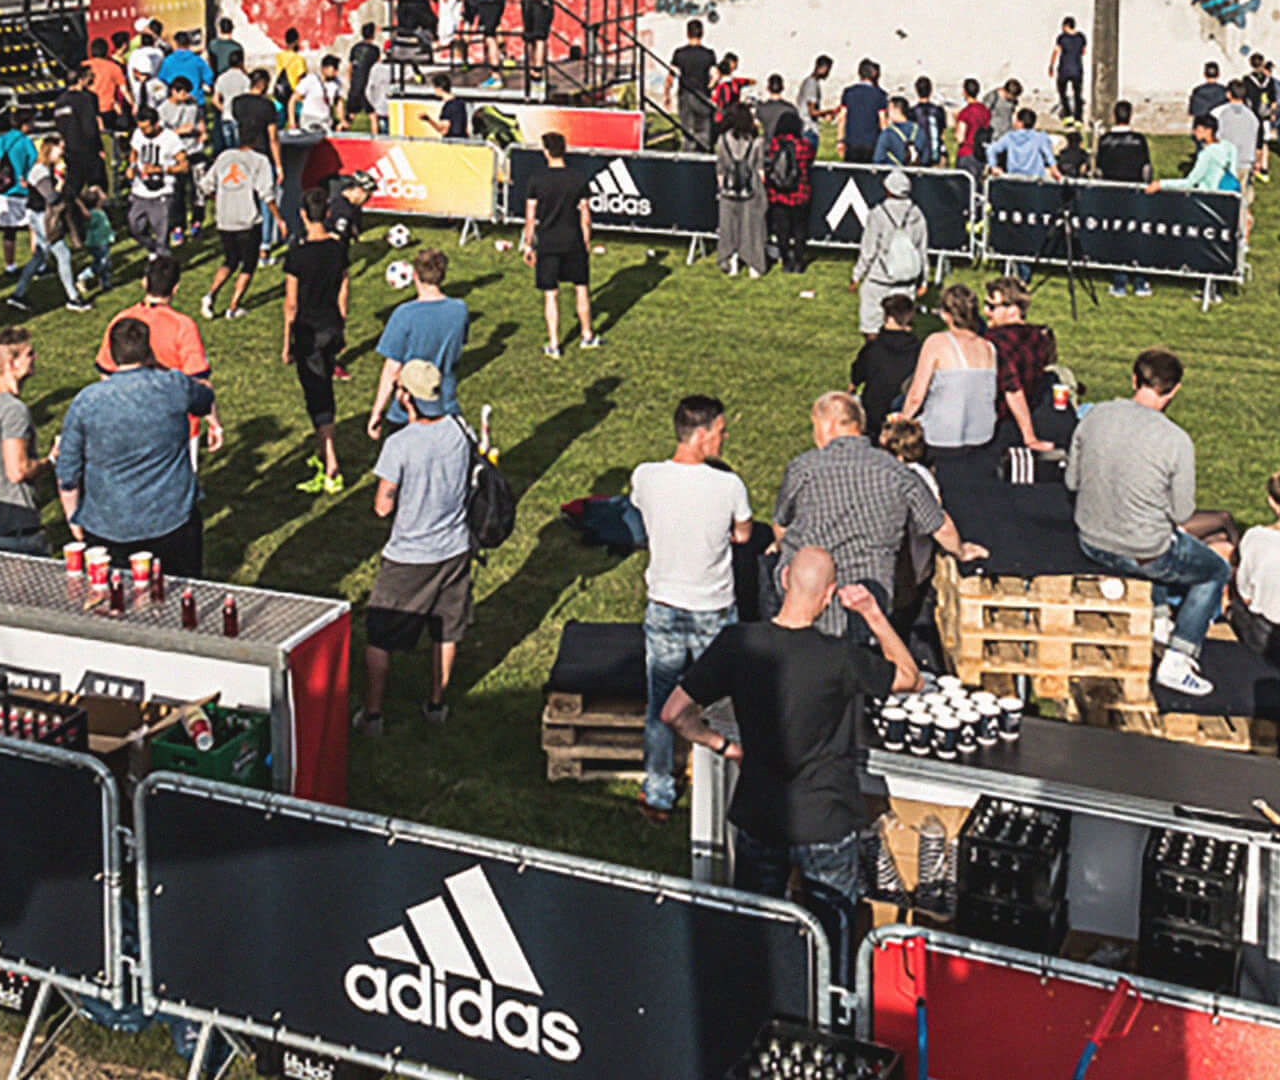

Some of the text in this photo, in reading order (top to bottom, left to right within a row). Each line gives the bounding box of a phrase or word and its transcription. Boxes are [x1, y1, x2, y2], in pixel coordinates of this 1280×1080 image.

[373, 178, 428, 200] didas
[587, 191, 652, 216] didas
[344, 962, 582, 1062] adidas
